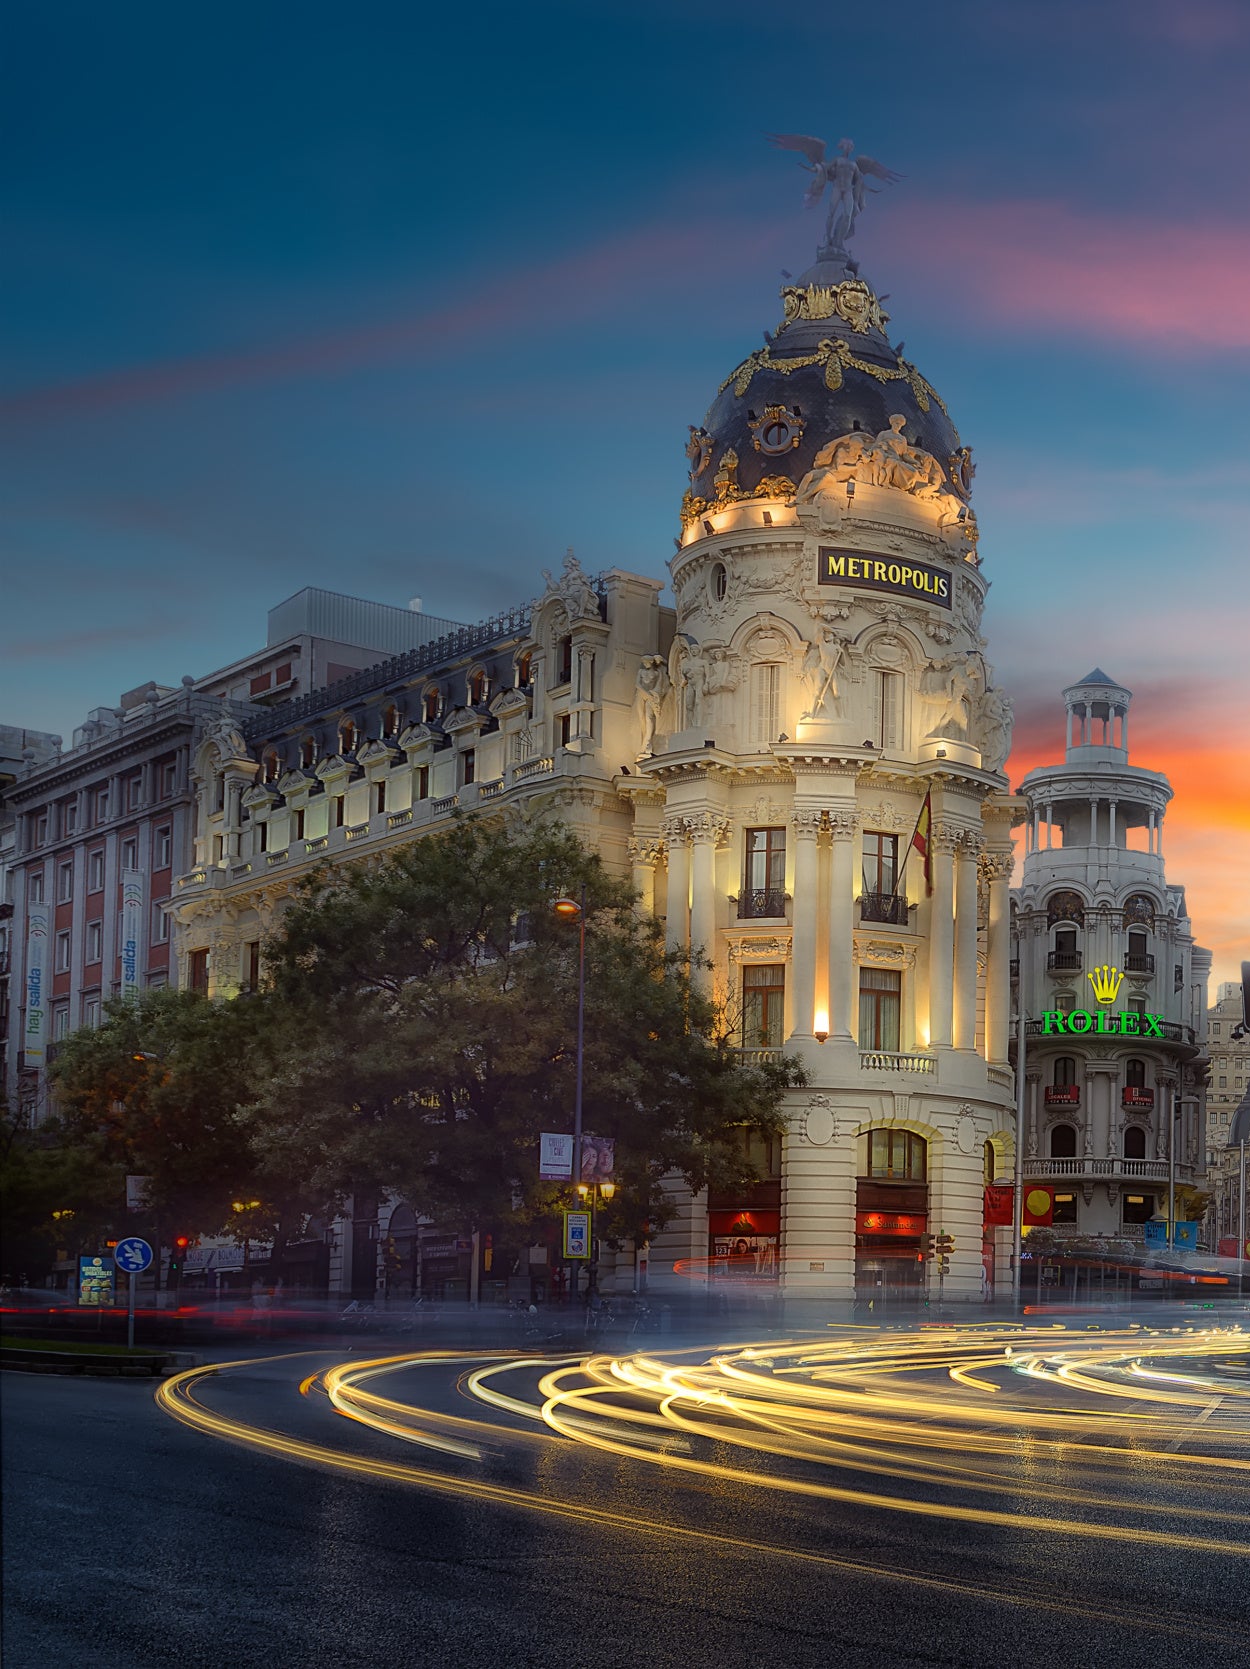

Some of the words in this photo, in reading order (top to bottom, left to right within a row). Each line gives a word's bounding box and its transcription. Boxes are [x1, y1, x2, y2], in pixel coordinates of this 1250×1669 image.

[828, 555, 948, 598] METROPOLIS
[123, 940, 137, 982] salida
[27, 968, 41, 1007] salida
[27, 1009, 43, 1034] hay
[1041, 1009, 1166, 1038] ROLEX
[878, 1218, 917, 1229] Santander
